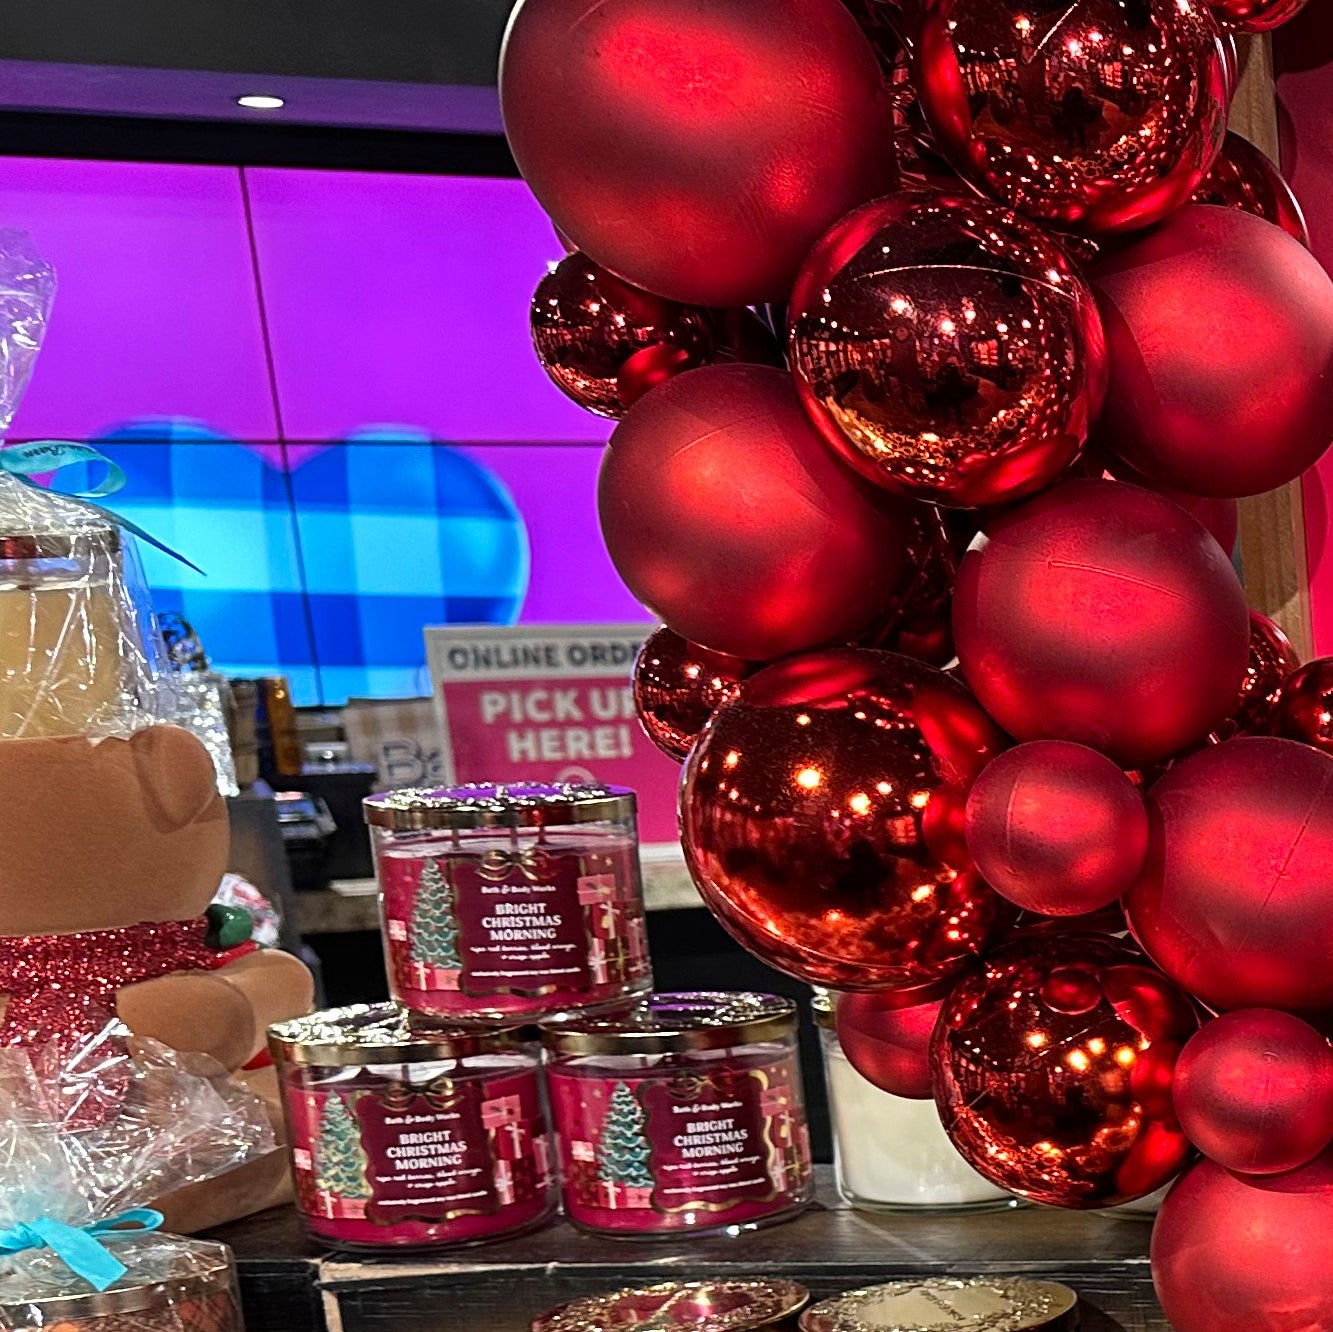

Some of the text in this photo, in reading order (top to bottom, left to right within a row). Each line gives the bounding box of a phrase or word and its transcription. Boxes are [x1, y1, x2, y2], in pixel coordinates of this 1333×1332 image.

[450, 646, 555, 670] ONLINE
[481, 689, 586, 724] PICK
[508, 725, 634, 762] HERE!
[495, 903, 547, 915] BRIGHT
[482, 915, 562, 928] CHRISTMAS
[490, 928, 557, 941] MORNING
[686, 1118, 735, 1134] BRIGHT
[399, 1131, 451, 1145] BRIGHT
[674, 1129, 748, 1146] CHRISTMAS
[386, 1141, 468, 1158] CHRISTMAS
[682, 1142, 744, 1158] MORNING
[395, 1154, 462, 1170] MORNING
